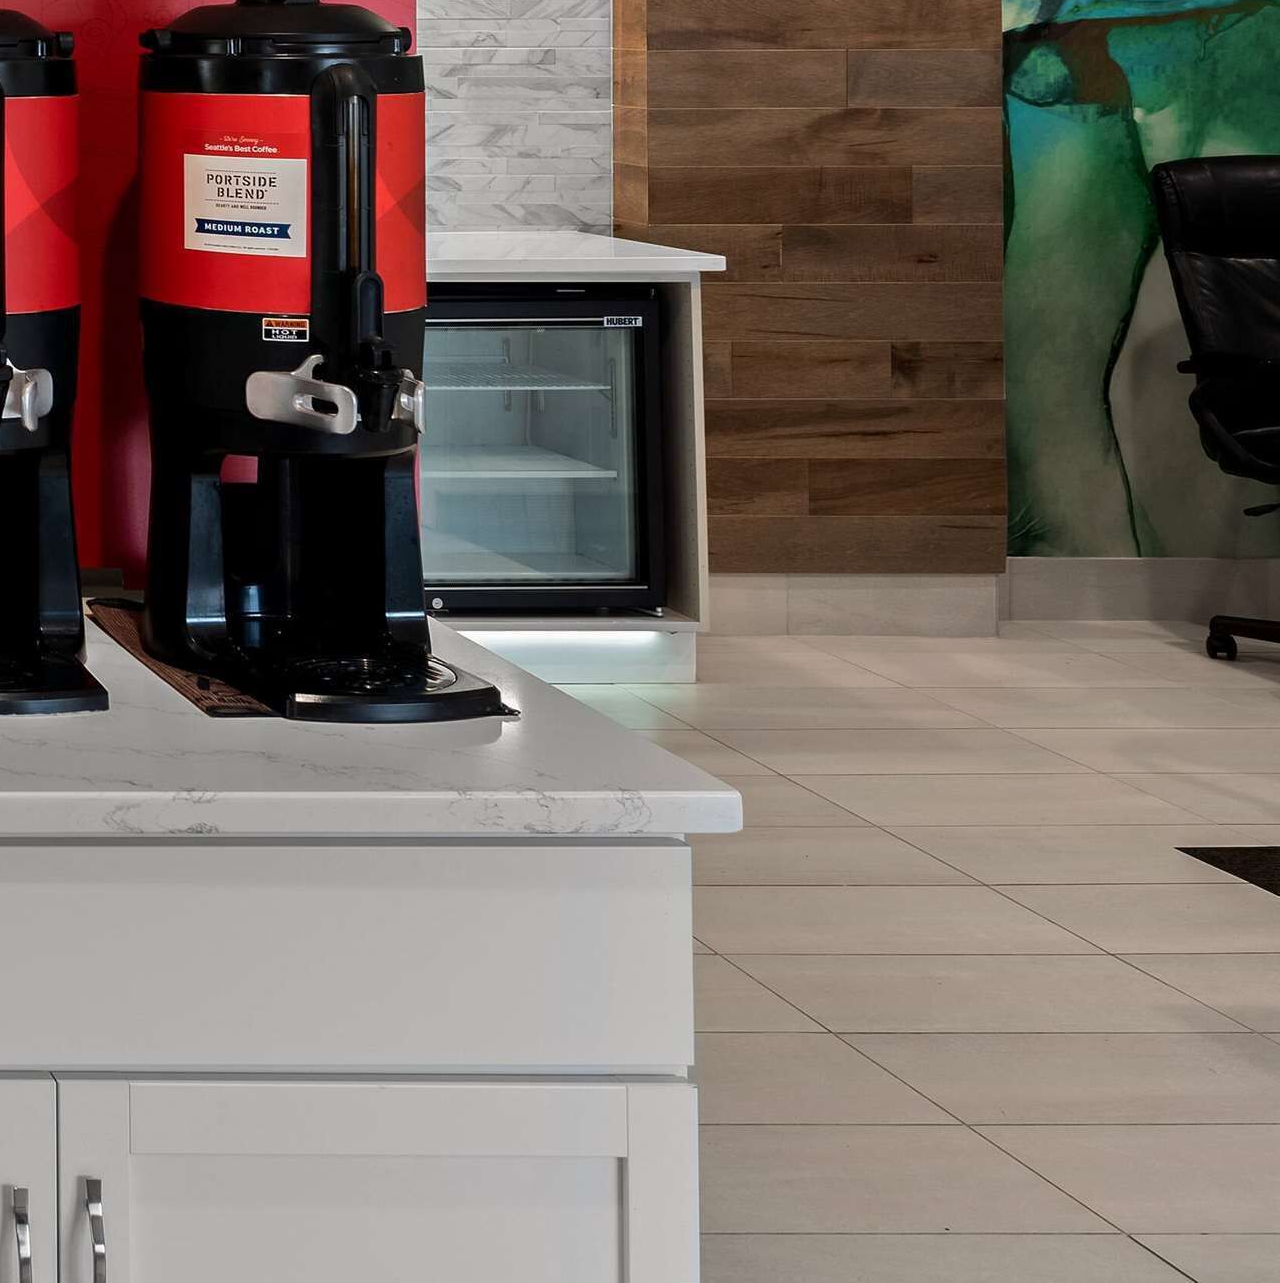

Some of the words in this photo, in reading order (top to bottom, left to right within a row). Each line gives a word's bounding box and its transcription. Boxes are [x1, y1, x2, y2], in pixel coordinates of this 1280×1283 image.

[206, 173, 278, 188] PORTSIDE
[217, 187, 265, 199] BLEND
[204, 223, 242, 232] MEDIUM
[245, 226, 279, 235] ROAST
[606, 317, 640, 325] HUBERT
